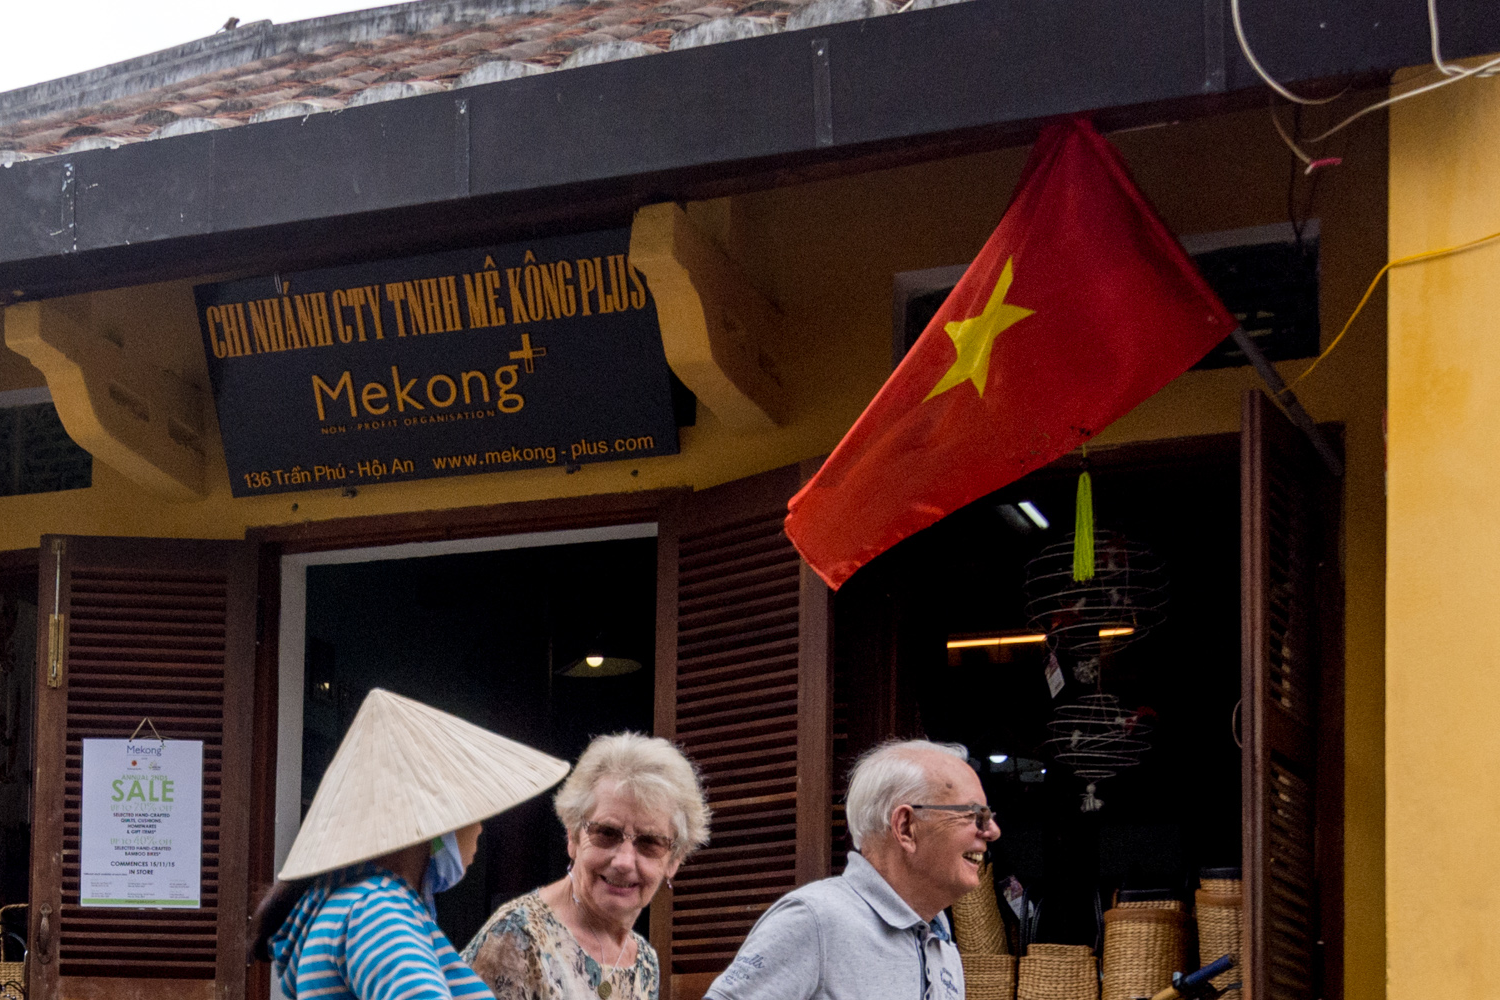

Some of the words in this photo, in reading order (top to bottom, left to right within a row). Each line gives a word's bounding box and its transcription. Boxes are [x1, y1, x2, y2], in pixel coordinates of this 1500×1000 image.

[206, 303, 251, 358] CHI
[248, 281, 334, 354] NHÁNH
[332, 285, 384, 343] CTY
[386, 276, 463, 337] TNHH
[463, 255, 506, 328] MÊ
[506, 250, 577, 324] KÔNG
[576, 254, 646, 317] PLUS
[311, 362, 525, 421] Mekong
[321, 426, 346, 435] NON
[358, 419, 398, 431] PROFIT
[404, 409, 496, 426] ORGANISATION
[244, 471, 271, 489] 136
[272, 465, 311, 486] Trần
[357, 459, 388, 480] Hội
[391, 458, 415, 474] An
[127, 746, 162, 756] Mekong
[111, 779, 174, 802] SALE
